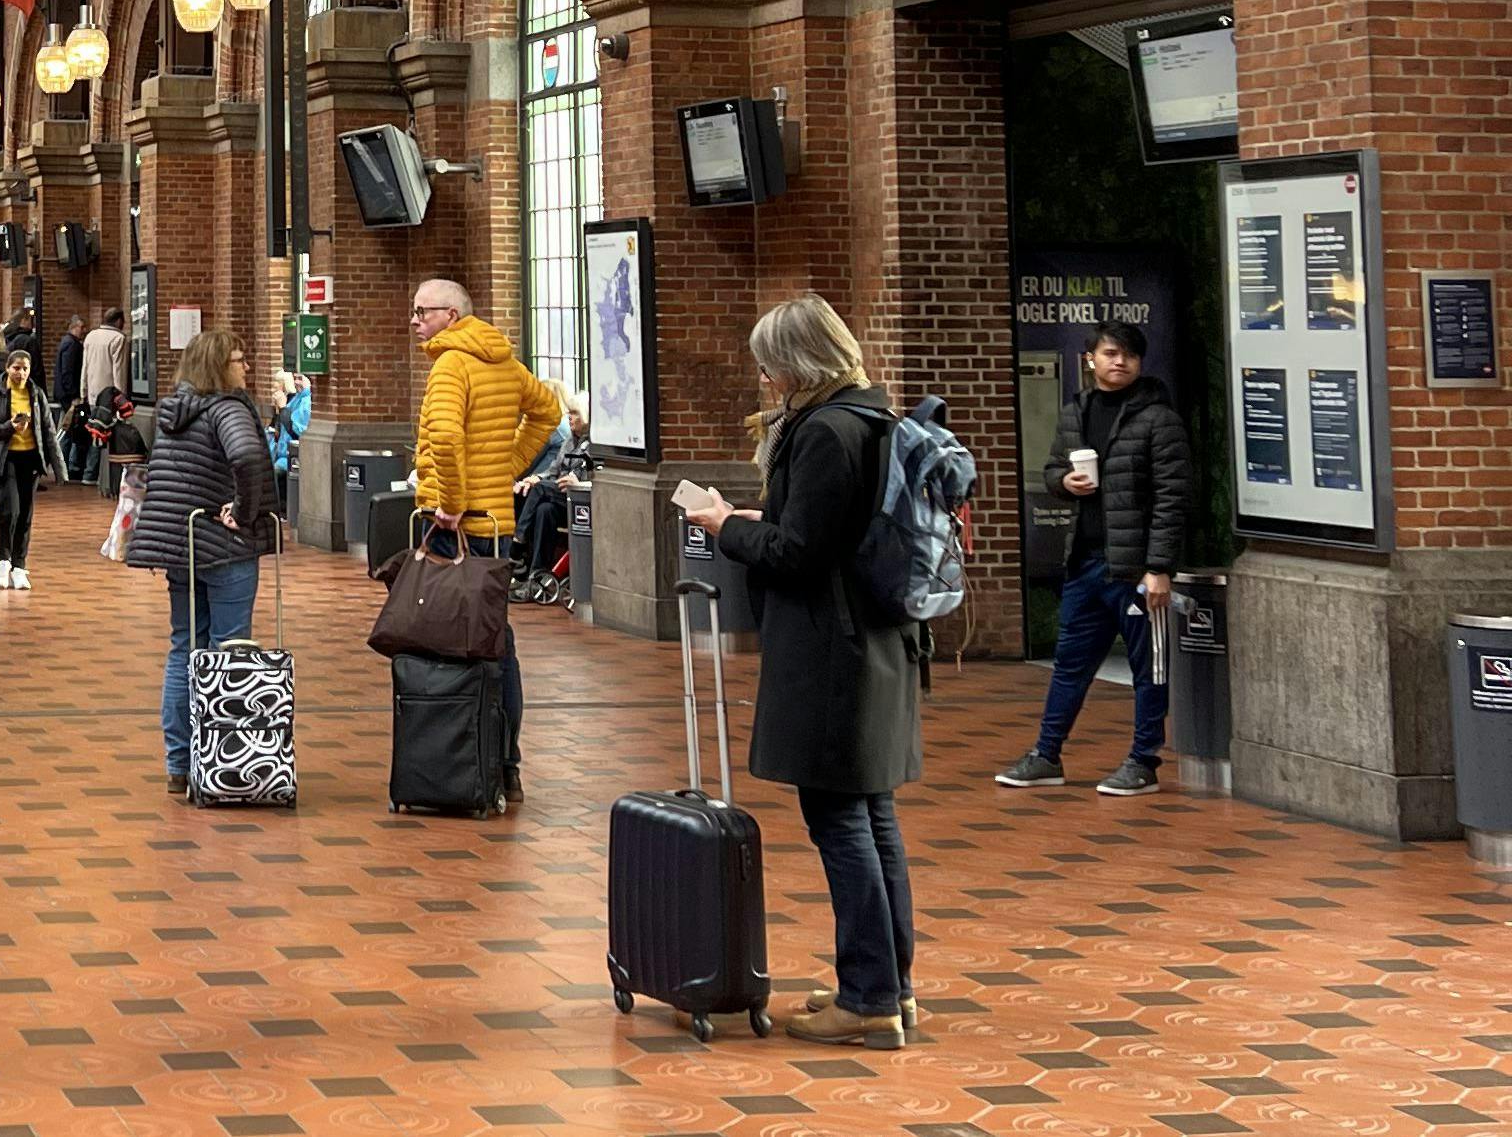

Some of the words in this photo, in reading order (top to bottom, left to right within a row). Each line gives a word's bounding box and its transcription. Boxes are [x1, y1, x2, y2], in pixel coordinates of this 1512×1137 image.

[1021, 276, 1039, 297] ER
[1043, 276, 1063, 297] DU
[1067, 276, 1103, 297] KLAR
[1106, 276, 1128, 297] TIL
[1059, 303, 1100, 323] PIXEL
[1100, 304, 1110, 321] 7
[1113, 304, 1150, 323] PRO?
